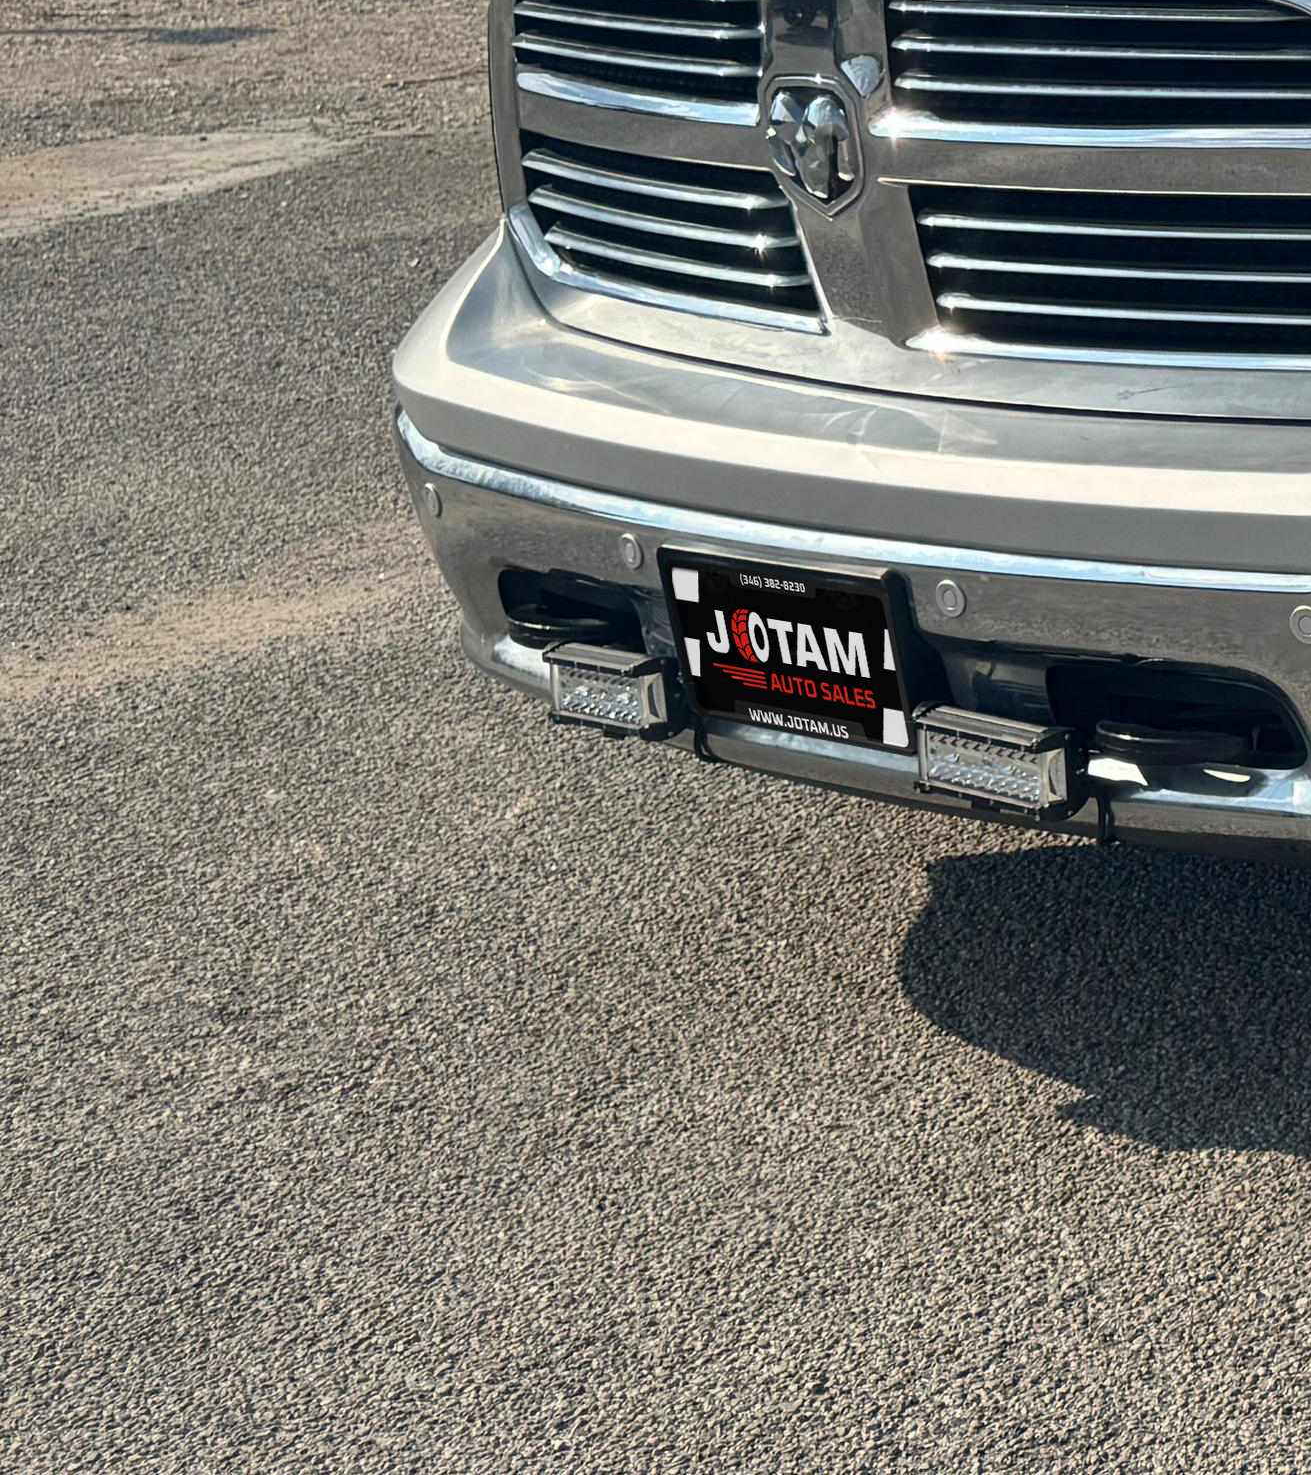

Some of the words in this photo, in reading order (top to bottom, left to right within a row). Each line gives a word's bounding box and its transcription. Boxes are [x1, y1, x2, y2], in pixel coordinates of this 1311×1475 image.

[739, 573, 762, 589] (346)
[763, 577, 806, 593] 382-8230
[706, 609, 870, 679] JOTAM
[771, 673, 817, 698] AUTO
[820, 682, 876, 709] SALES
[748, 707, 850, 739] WWW.JOTAM.US
